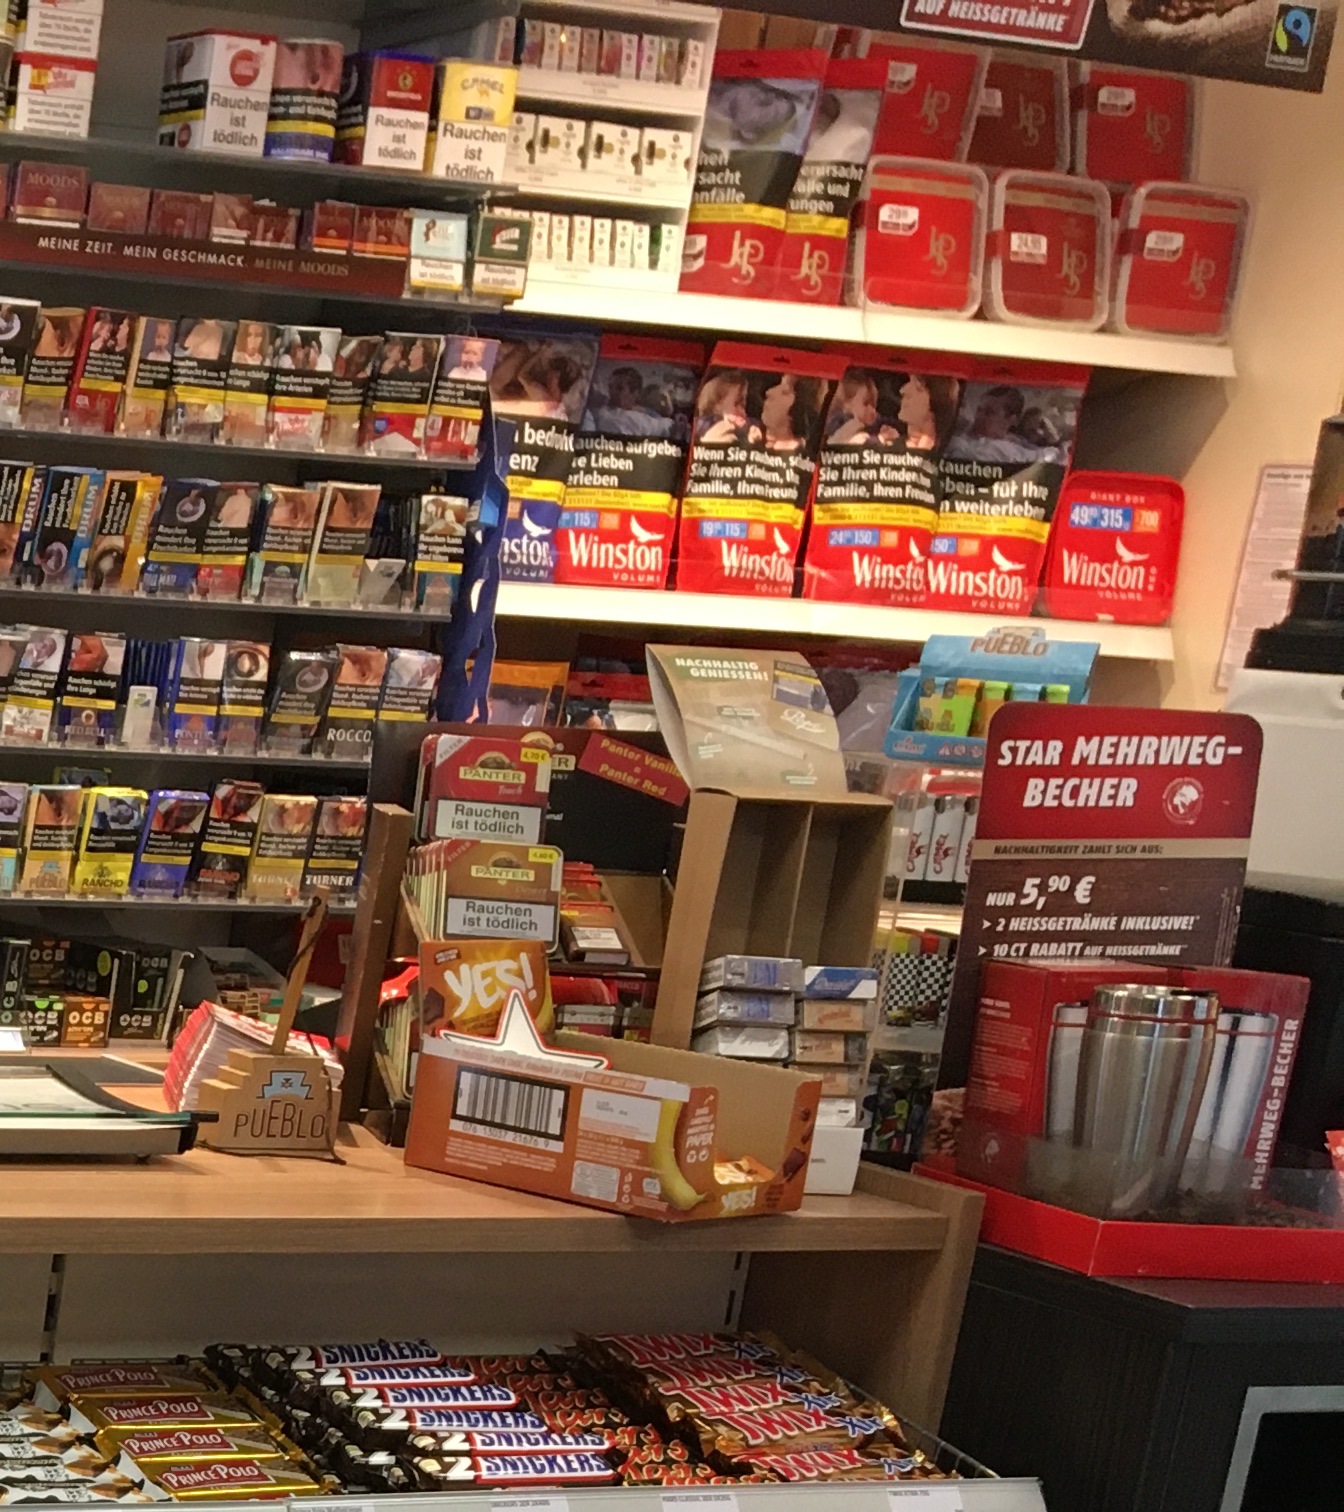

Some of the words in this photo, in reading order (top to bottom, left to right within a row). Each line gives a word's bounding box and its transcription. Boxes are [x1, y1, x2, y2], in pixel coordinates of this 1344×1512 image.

[948, 4, 1066, 32] HEISSGETRÄNKE
[211, 93, 268, 113] Rauchen
[230, 114, 246, 128] ist
[213, 128, 257, 147] tödlich
[38, 236, 79, 253] MEINE
[123, 245, 157, 259] MEIN
[23, 478, 42, 532] DRUM
[568, 530, 662, 572] Winston
[927, 562, 1023, 599] Winston
[675, 657, 759, 672] NACHHALTIG
[690, 668, 769, 681] GENIESSEN!
[328, 727, 371, 744] ROCCO
[601, 740, 641, 761] Panter
[998, 740, 1062, 766] STAR
[1072, 736, 1243, 766] MEHRWEG-
[463, 769, 522, 782] PANTER
[599, 764, 638, 785] Panter
[642, 779, 667, 796] Red
[1023, 778, 1138, 808] BECHER
[454, 804, 519, 820] Rauchen
[451, 818, 469, 830] ist
[474, 820, 524, 835] tödlich
[994, 845, 1078, 854] NACHHALTIGKEIT
[1082, 845, 1112, 854] ZAHLT
[1116, 845, 1136, 854] SICH
[1140, 845, 1164, 854] AUS:
[305, 875, 353, 888] TURNER
[475, 868, 530, 879] PANTER
[82, 876, 124, 889] RANCHO
[986, 892, 1014, 906] NUR
[1074, 876, 1096, 904] €
[465, 902, 532, 917] Rauchen
[463, 916, 481, 926] ist
[486, 917, 538, 931] tödlich
[996, 918, 1005, 931] 2
[1009, 913, 1116, 931] HEISSGETRÄNKE
[29, 949, 65, 962] OCB
[992, 944, 1006, 956] 10
[1010, 944, 1027, 956] CT
[1030, 942, 1083, 956] RABATT
[1084, 946, 1102, 956] AUF
[443, 953, 537, 1018] YES!
[69, 1011, 104, 1024] OCB
[1251, 1019, 1299, 1190] MEHRWEG-BECHER
[483, 1453, 609, 1480] SNICKERS
